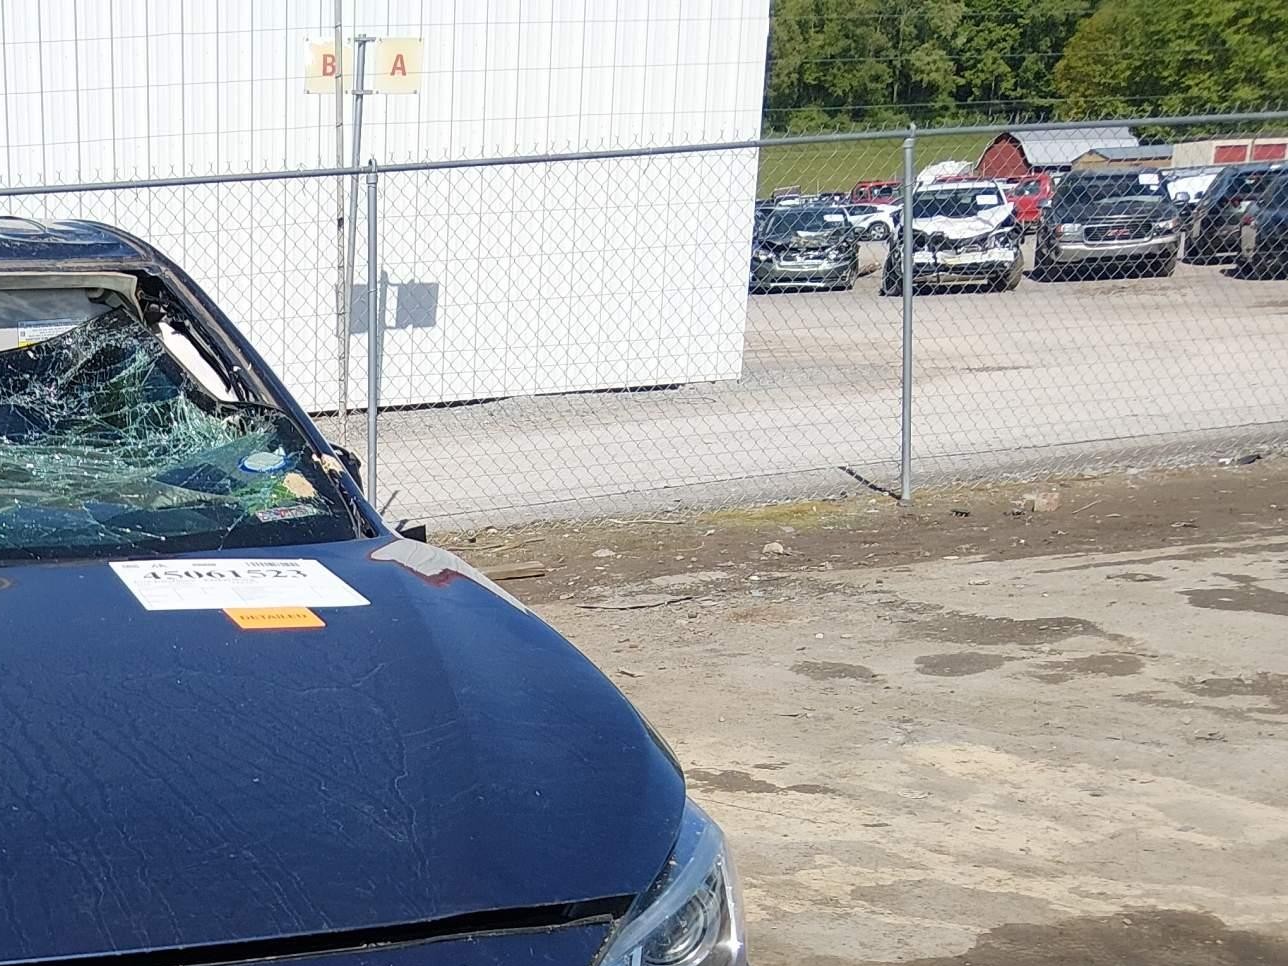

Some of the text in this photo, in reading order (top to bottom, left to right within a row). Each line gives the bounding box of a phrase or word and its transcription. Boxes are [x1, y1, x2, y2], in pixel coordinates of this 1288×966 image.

[322, 53, 337, 77] B
[389, 53, 407, 77] A
[143, 569, 308, 580] 45061523
